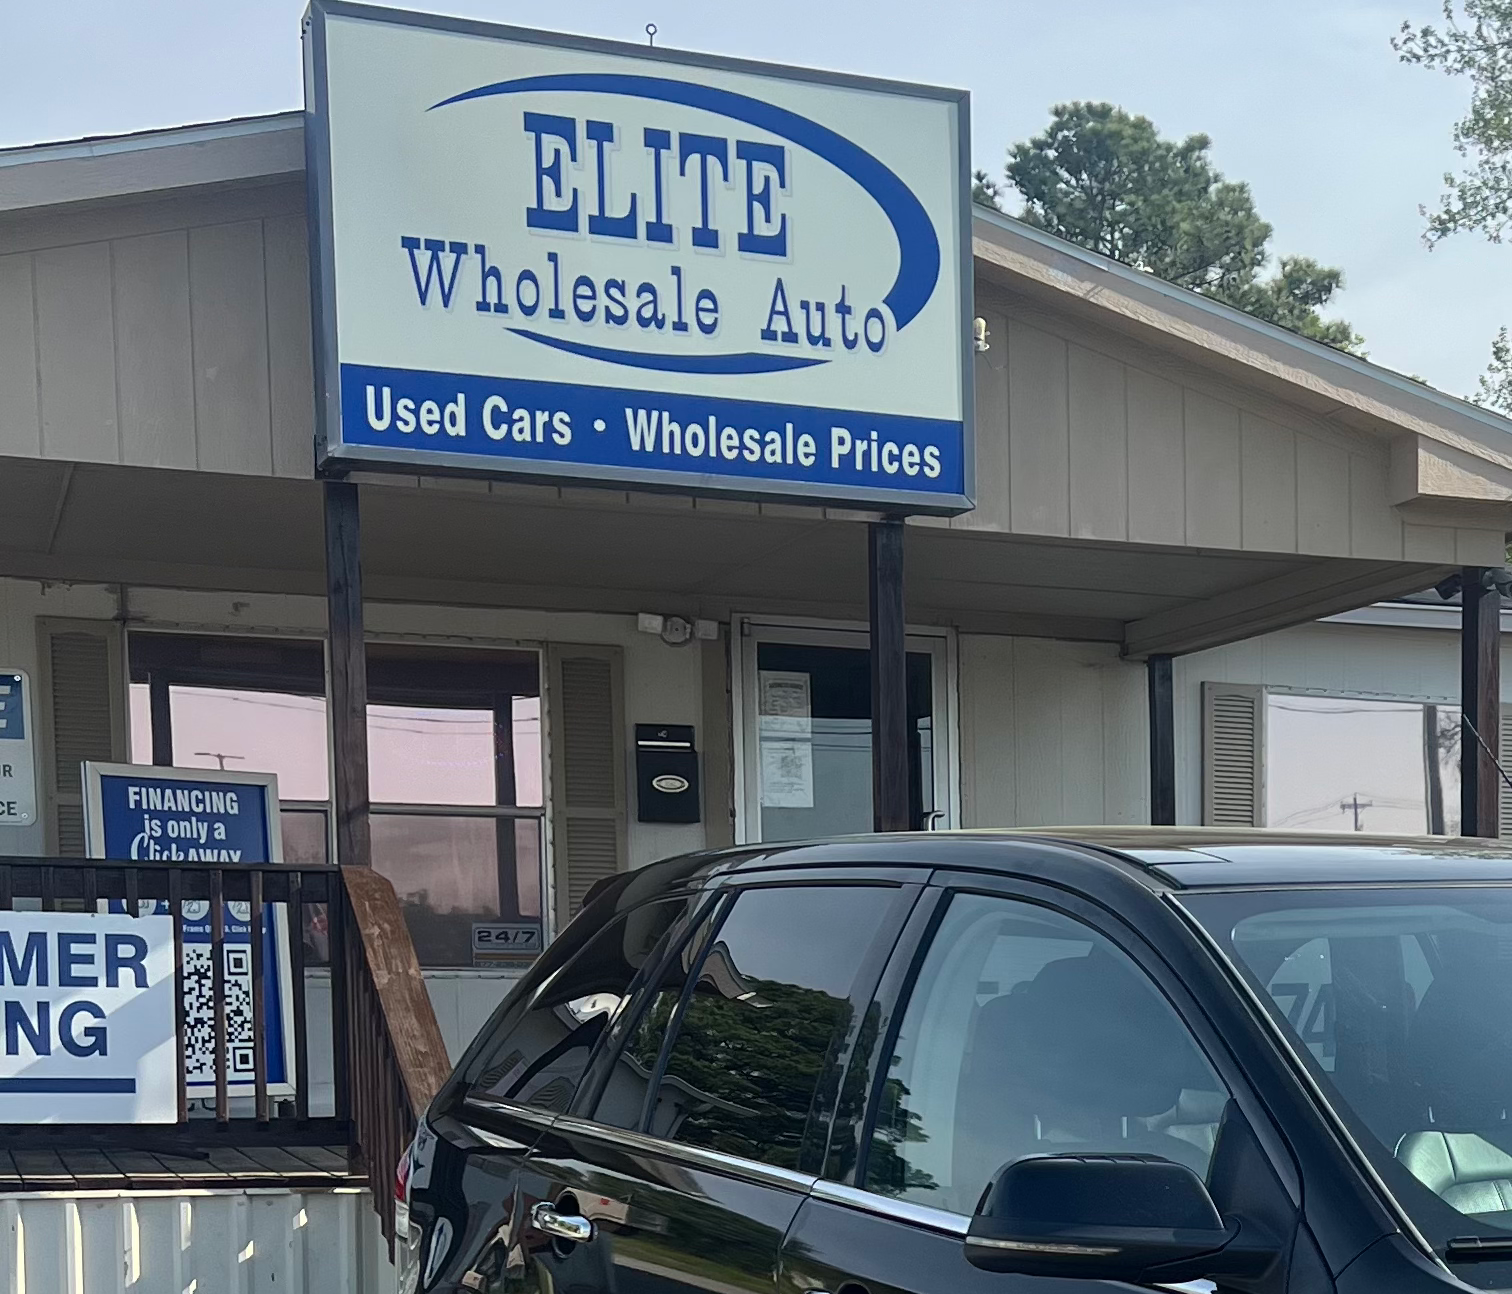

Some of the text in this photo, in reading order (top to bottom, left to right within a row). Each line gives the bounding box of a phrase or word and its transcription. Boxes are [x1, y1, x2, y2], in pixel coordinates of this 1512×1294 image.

[523, 111, 787, 258] ELITE
[401, 235, 887, 354] Wholesale Auto
[365, 385, 942, 479] Used Cars Wholesale Prices
[128, 786, 239, 815] FINANCING
[143, 814, 226, 844] is only a
[130, 832, 242, 863] Click AWAY
[0, 931, 149, 989] MER
[477, 930, 536, 943] 24/7
[5, 1000, 107, 1057] NG
